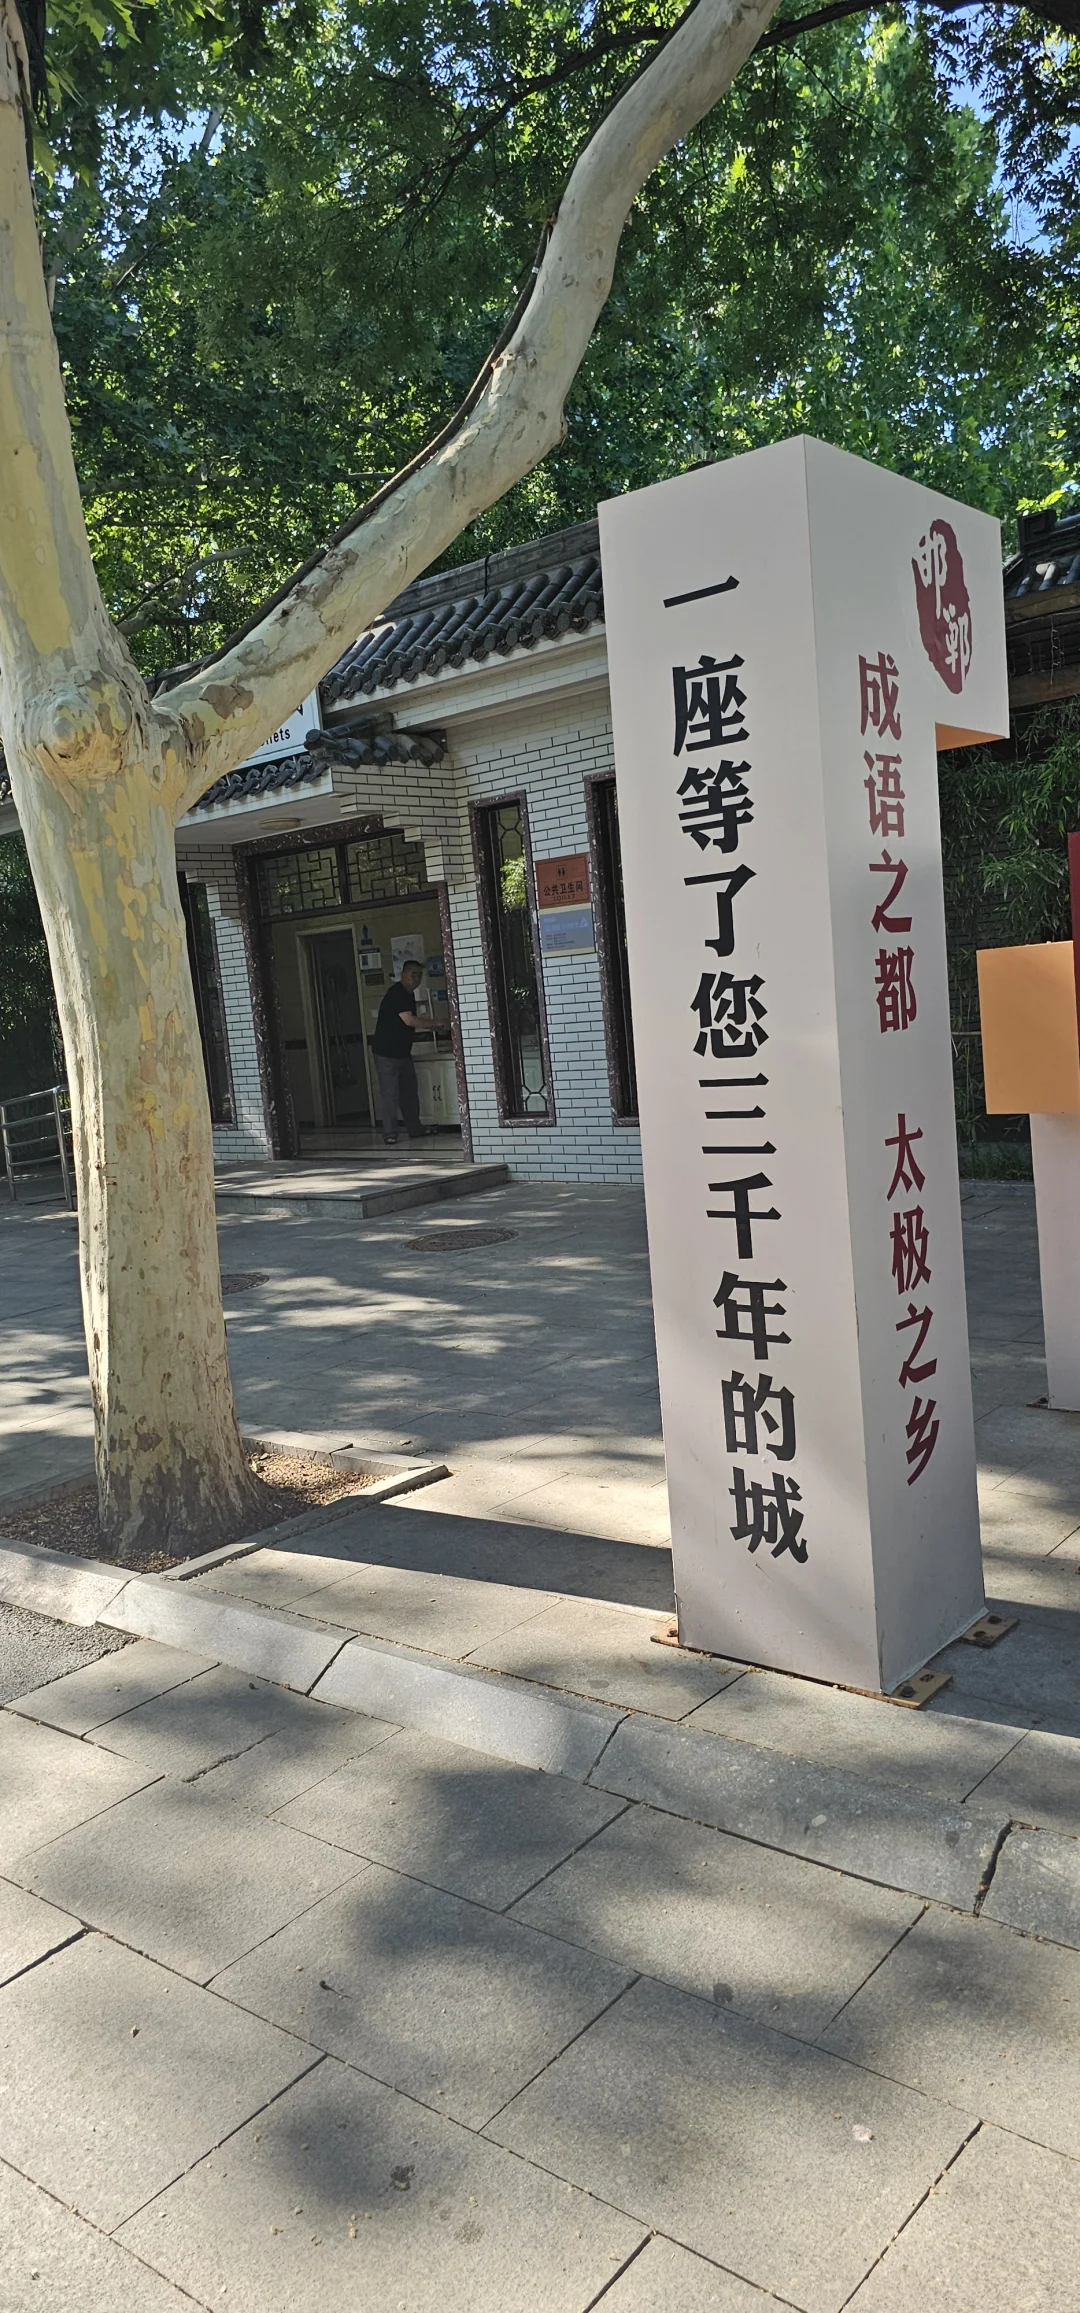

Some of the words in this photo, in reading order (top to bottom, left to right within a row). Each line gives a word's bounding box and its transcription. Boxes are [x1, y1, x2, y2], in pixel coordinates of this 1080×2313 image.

[912, 530, 971, 686] 邯郸
[543, 880, 584, 897] 公共卫生间
[553, 894, 576, 902] TOILET
[858, 650, 918, 1034] 成语之都
[662, 575, 809, 1564] 一座等了您三千年的城
[884, 1112, 941, 1487] 太极之乡
